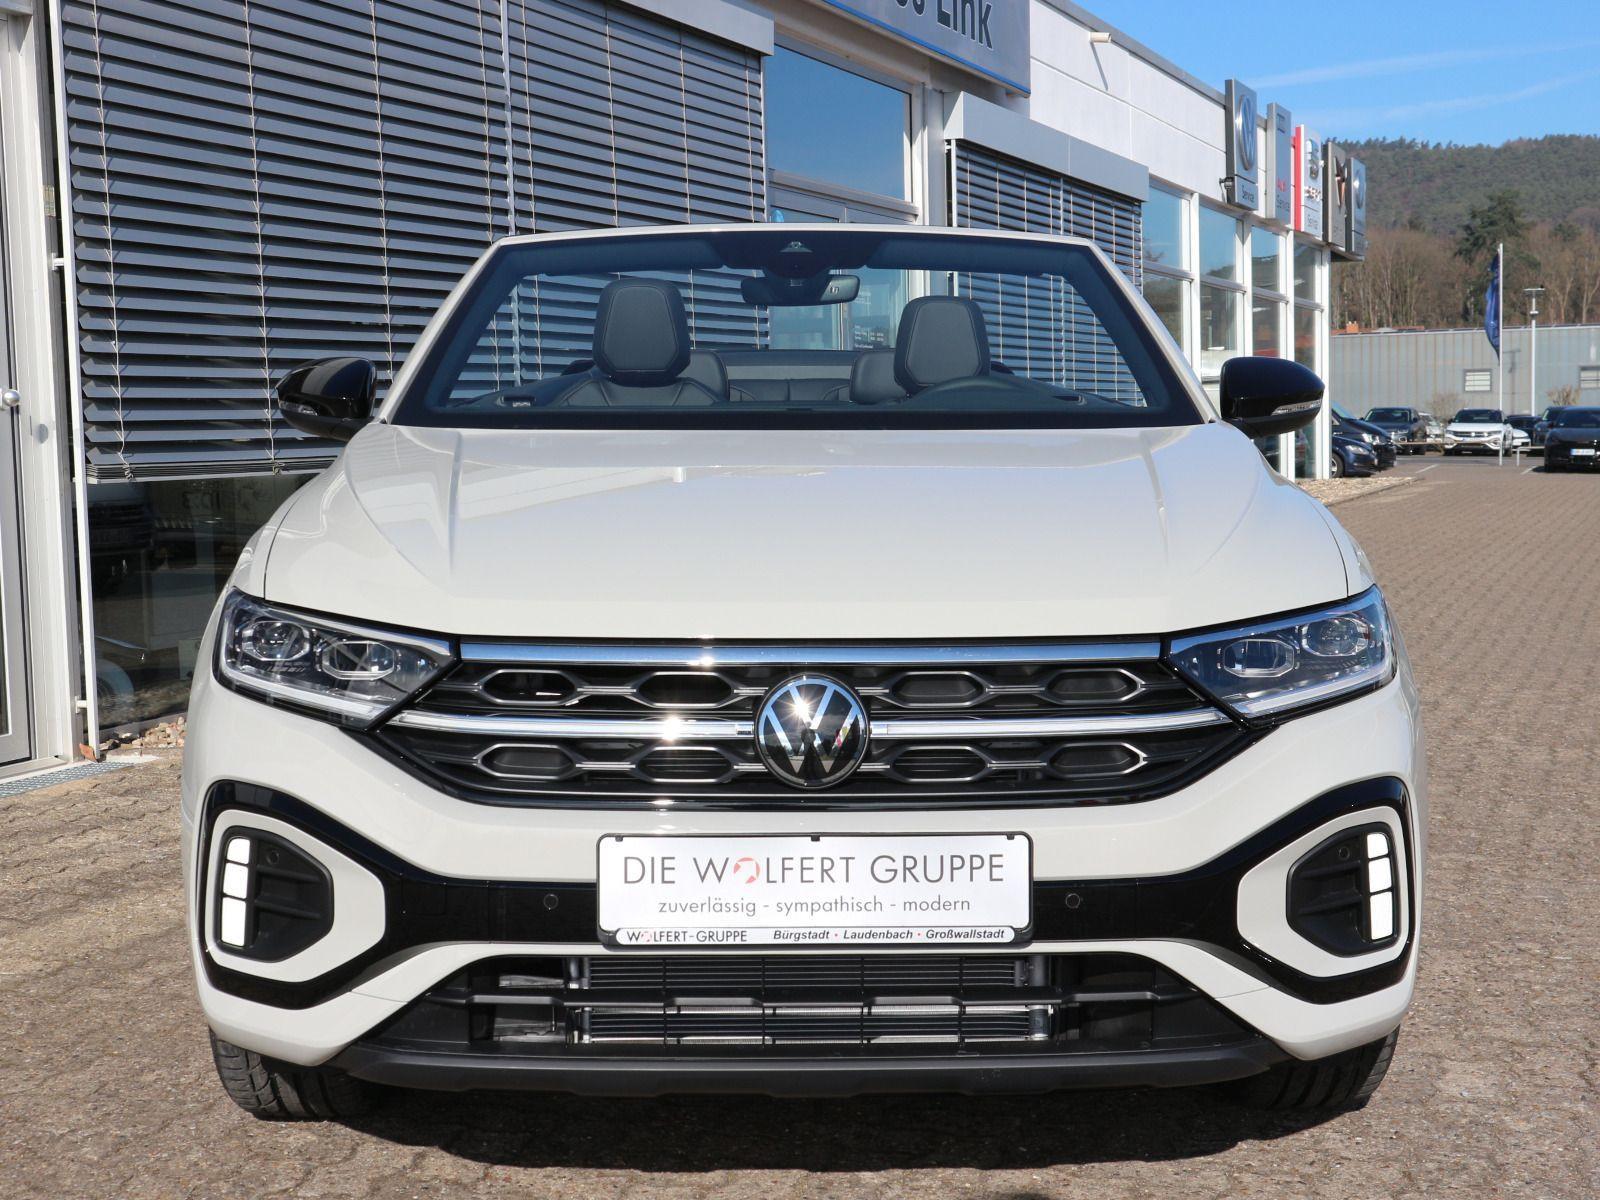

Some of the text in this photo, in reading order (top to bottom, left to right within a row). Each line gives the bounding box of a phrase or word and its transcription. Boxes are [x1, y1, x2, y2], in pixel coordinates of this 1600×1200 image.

[624, 854, 1004, 884] DIE WOLFERT GRUPPE
[658, 896, 756, 917] zuverlässig
[776, 895, 883, 917] sympathisch
[903, 895, 970, 911] modern
[773, 929, 830, 941] Bürgstadt
[843, 929, 914, 940] Laudenbach
[925, 928, 1005, 940] Großwallstadt
